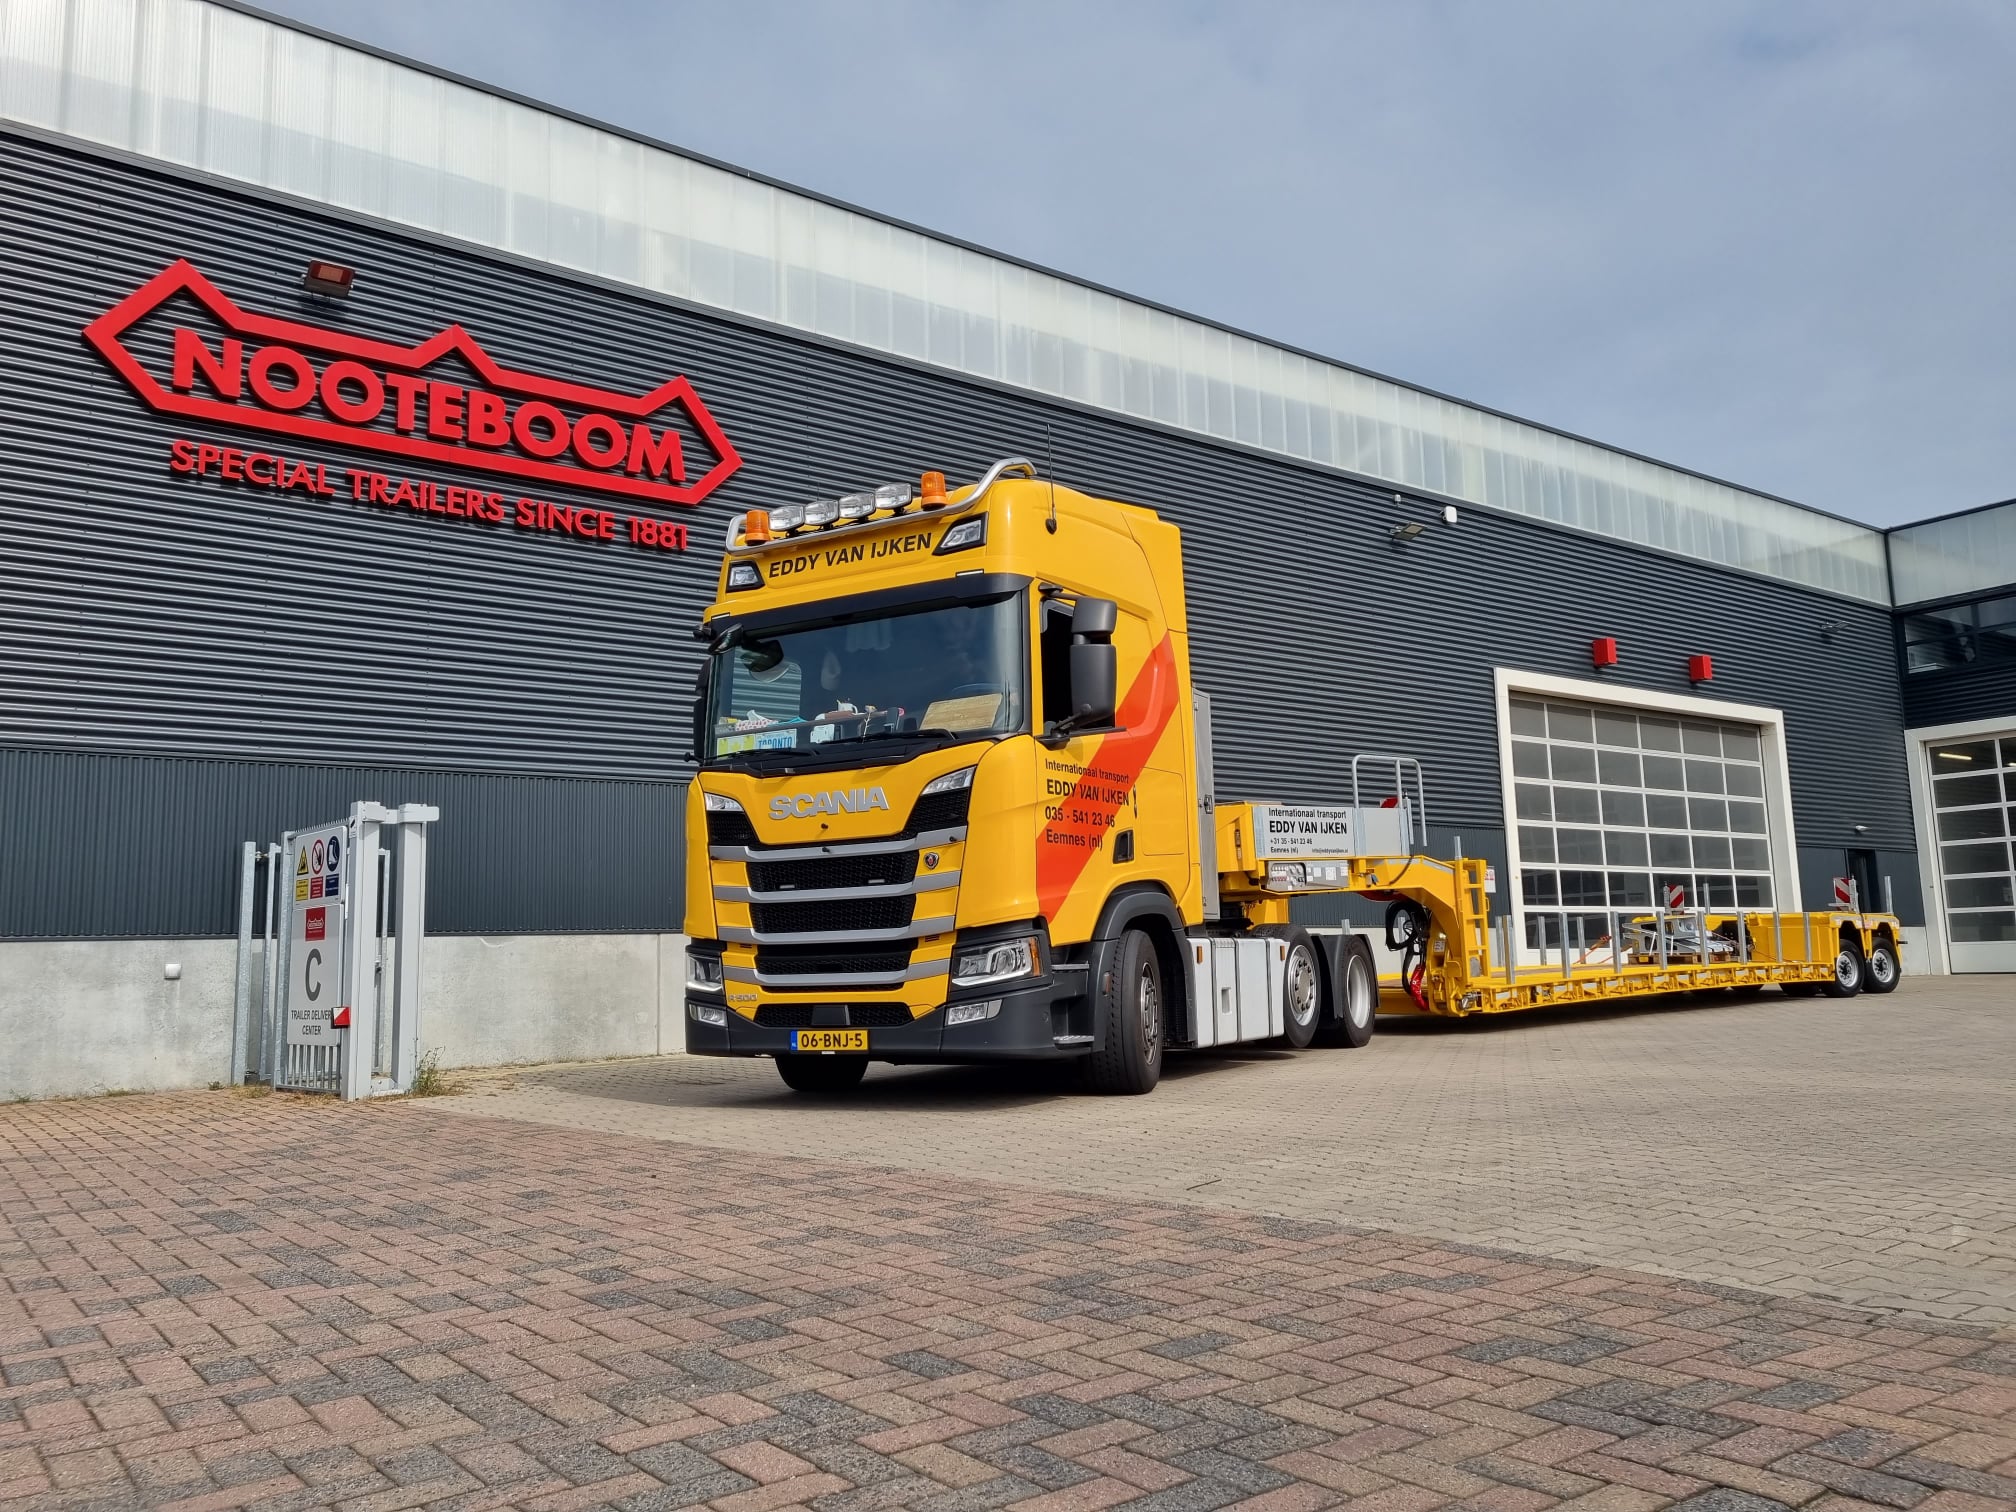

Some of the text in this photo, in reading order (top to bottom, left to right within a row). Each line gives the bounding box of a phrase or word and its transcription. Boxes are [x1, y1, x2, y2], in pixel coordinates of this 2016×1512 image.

[172, 327, 687, 481] NOOTEBOOM
[170, 439, 688, 551] SPECIAL TRAILERS SINCE 1881
[768, 532, 932, 579] EDDY VAN IJKEN
[1044, 757, 1130, 785] Internationaal transport
[768, 785, 890, 820] SCANIA
[1046, 778, 1130, 806] EDDY VAN IJKEN
[1045, 805, 1064, 822] 035
[1072, 809, 1089, 825] 541
[1092, 812, 1103, 827] 23
[1104, 814, 1116, 828] 46
[1268, 807, 1347, 820] Internationaal transport
[1269, 820, 1348, 835] EDDY VAN IJKEN
[1046, 829, 1103, 852] Eemnes (nl)
[1270, 846, 1290, 854] Eemnes
[304, 948, 322, 1002] C
[290, 1009, 332, 1020] TRAILER DELIVER
[302, 1025, 322, 1036] CENTER
[800, 1033, 863, 1048] 06-BNJ-5
